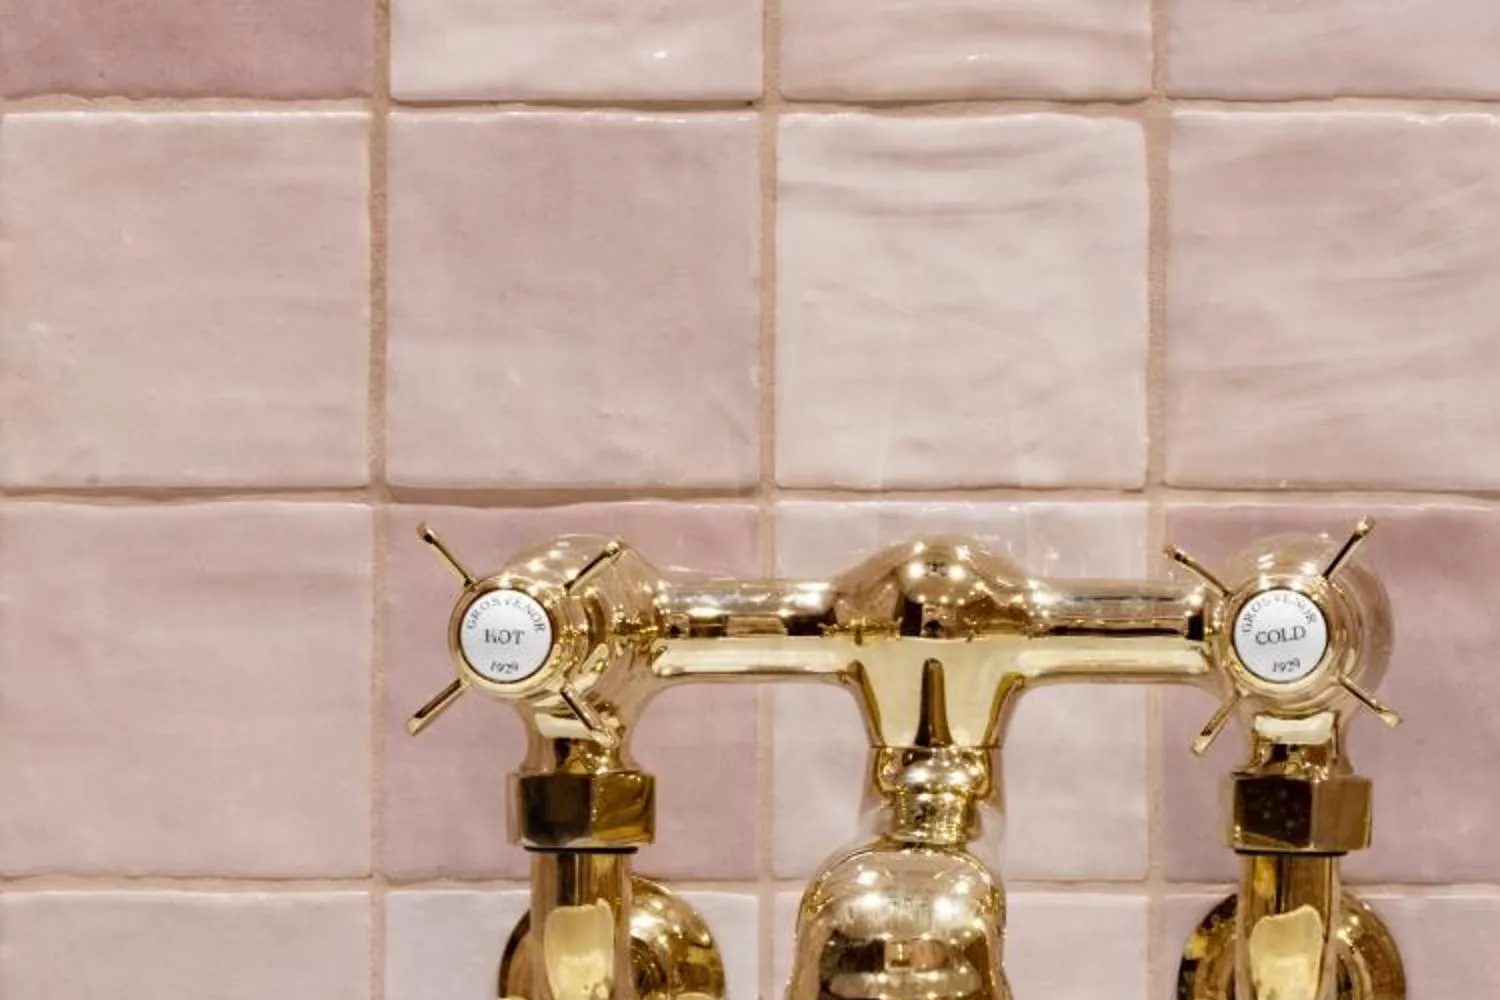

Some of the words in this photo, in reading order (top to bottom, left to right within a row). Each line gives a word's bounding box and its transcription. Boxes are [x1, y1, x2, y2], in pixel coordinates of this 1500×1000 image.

[467, 596, 546, 633] GROSVENOR
[484, 628, 526, 645] HOT
[1255, 625, 1307, 646] COLD
[489, 661, 520, 675] 1929
[1272, 657, 1301, 673] 1929
